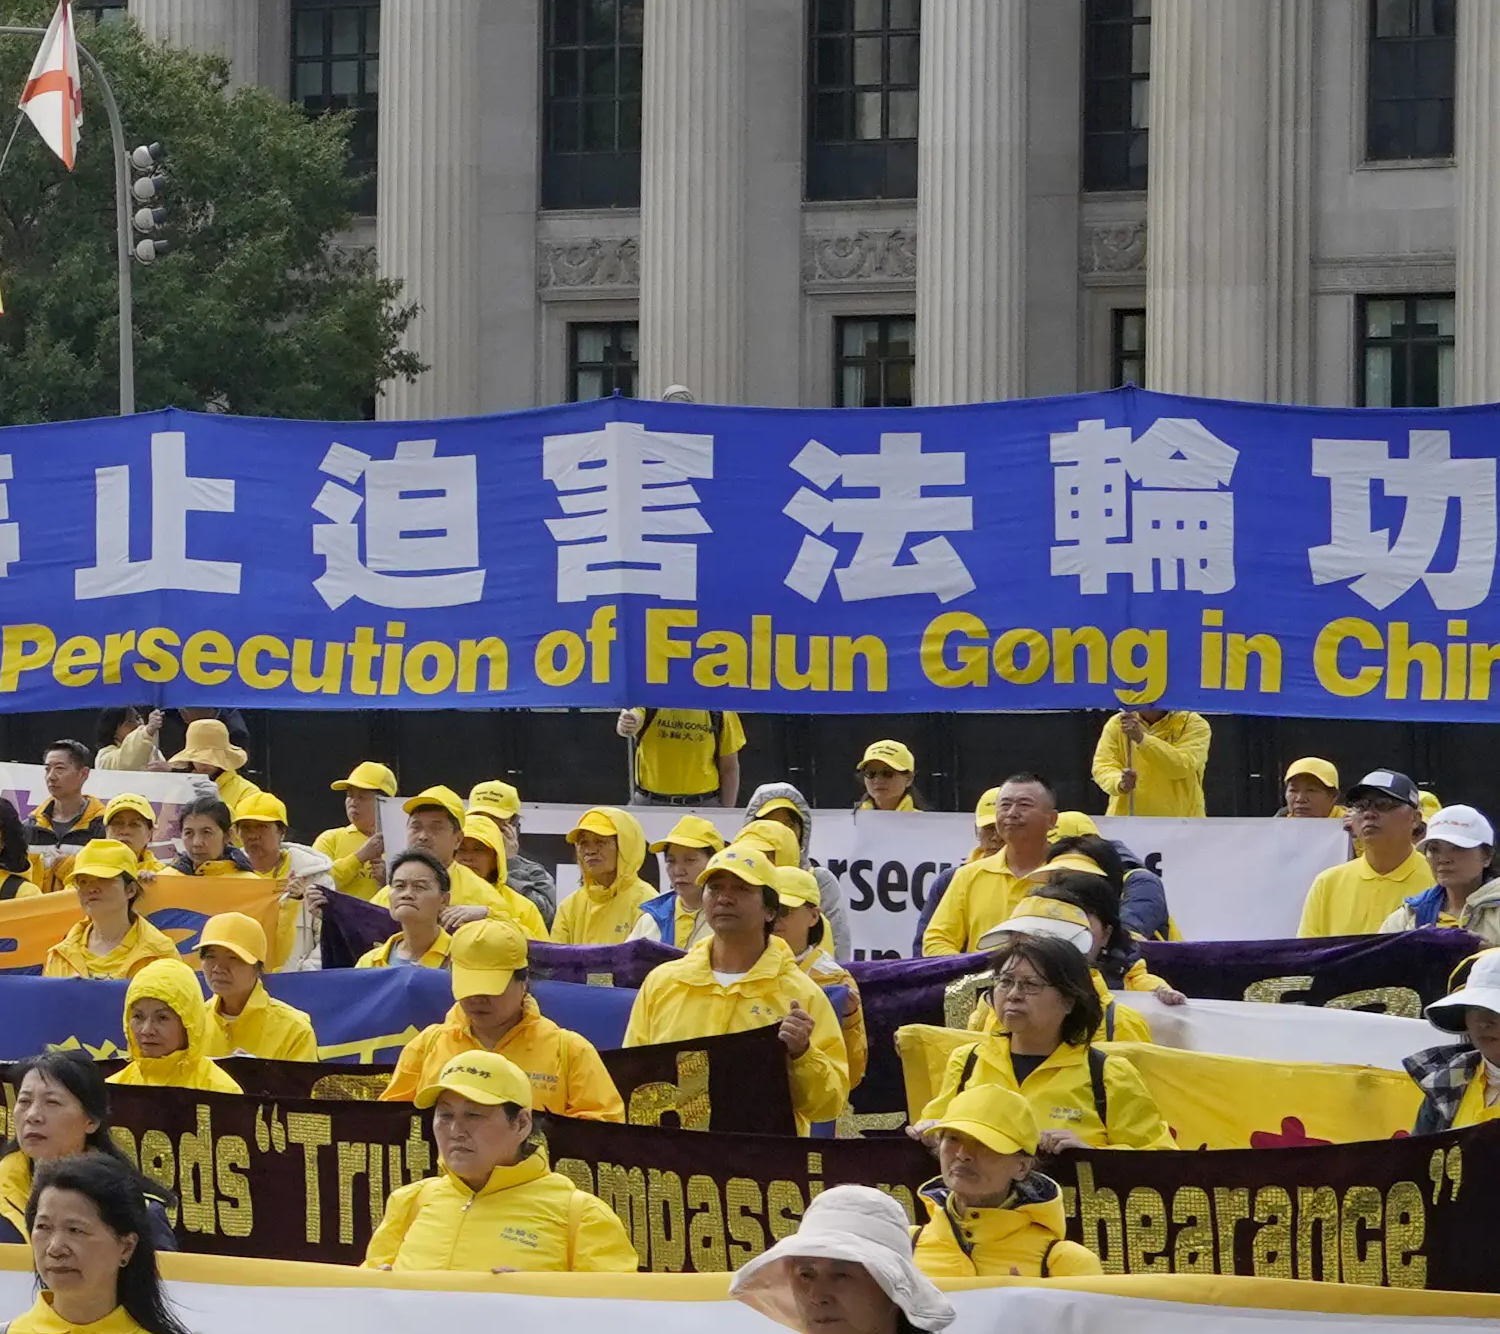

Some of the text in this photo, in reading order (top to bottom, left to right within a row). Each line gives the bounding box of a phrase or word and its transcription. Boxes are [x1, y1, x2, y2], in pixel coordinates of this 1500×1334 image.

[535, 605, 617, 686] of
[646, 608, 888, 692] Falun
[920, 611, 1168, 705] Gong
[1201, 610, 1282, 693] in
[1314, 617, 1500, 701] Chin
[114, 1104, 254, 1239] eds
